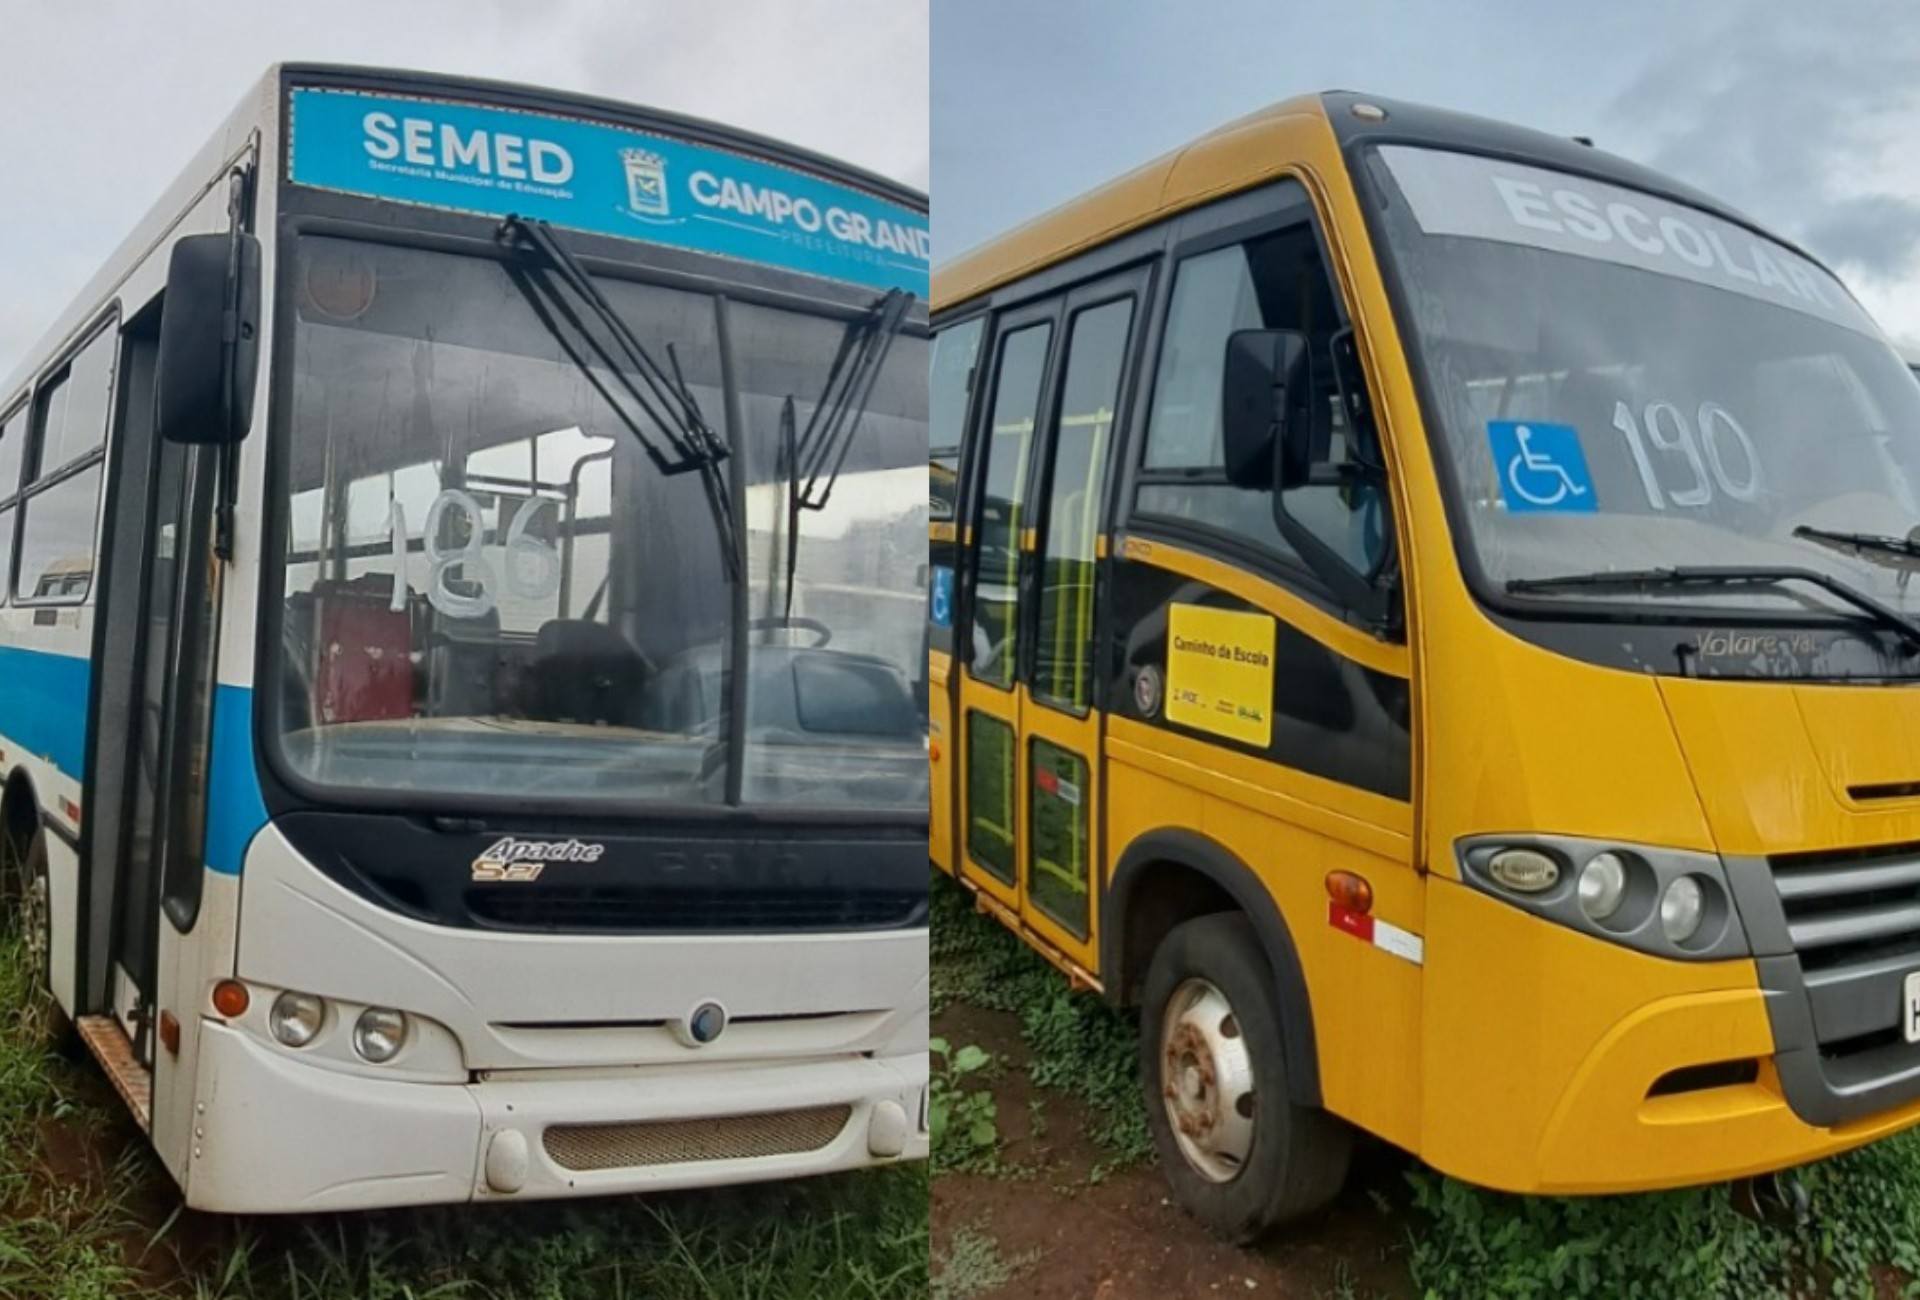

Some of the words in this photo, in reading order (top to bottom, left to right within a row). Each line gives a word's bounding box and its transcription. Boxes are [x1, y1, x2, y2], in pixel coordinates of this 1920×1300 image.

[363, 112, 574, 184] SEMED
[369, 159, 432, 178] Secretaria
[435, 169, 494, 187] Municipal
[497, 180, 512, 190] de
[515, 182, 574, 199] Educação
[688, 170, 822, 233] CAMPO
[1491, 175, 1834, 310] ESCOLAR
[1613, 401, 1764, 509] 190
[388, 489, 561, 618] 186
[1174, 635, 1216, 657] Caminho
[1218, 643, 1231, 660] da
[1233, 647, 1269, 668] Escola
[481, 836, 604, 863] Apache
